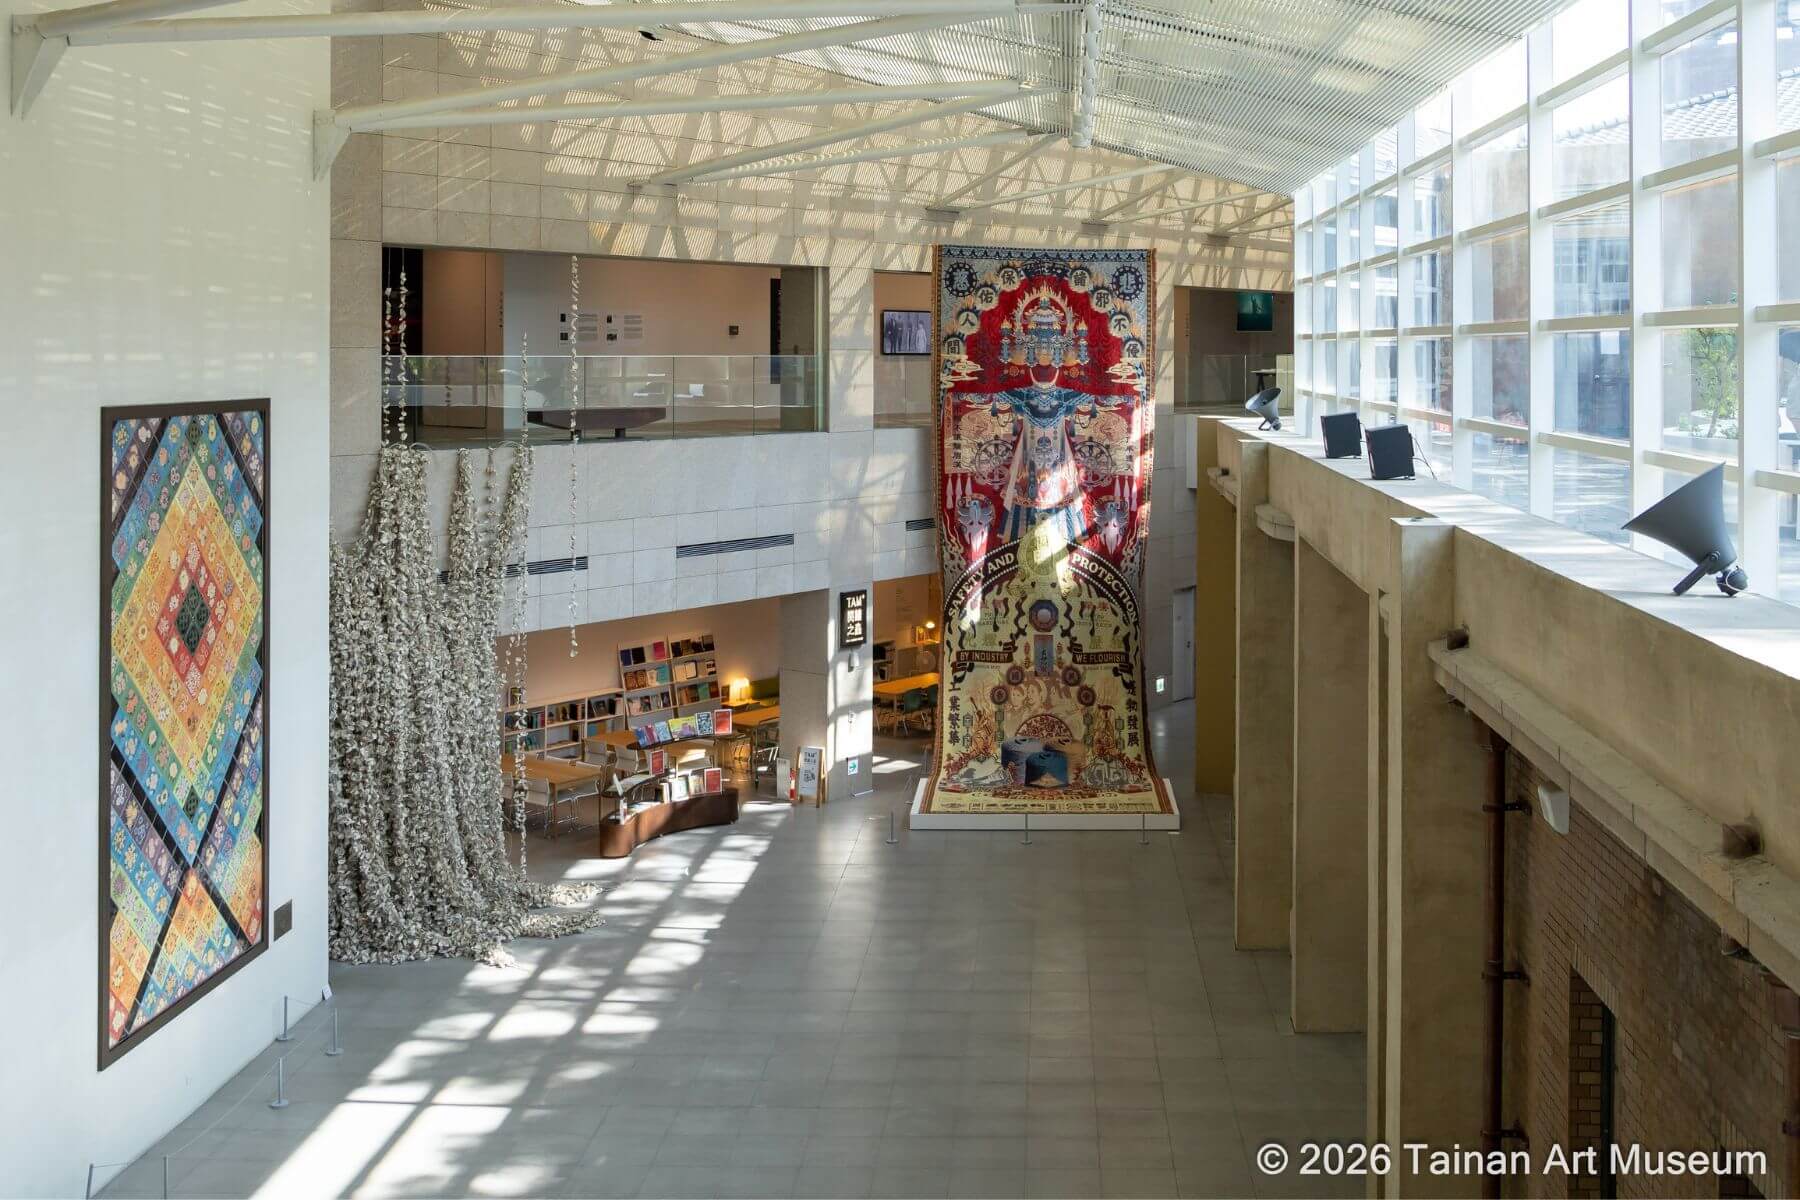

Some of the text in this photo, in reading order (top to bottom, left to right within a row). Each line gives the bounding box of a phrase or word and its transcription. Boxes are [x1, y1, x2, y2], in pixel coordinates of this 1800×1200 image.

[948, 552, 1138, 623] SAFETY AND PROTECTION
[960, 652, 1009, 662] BY INDUSTRY
[1075, 654, 1088, 663] WE
[1089, 653, 1126, 663] FLOURISH
